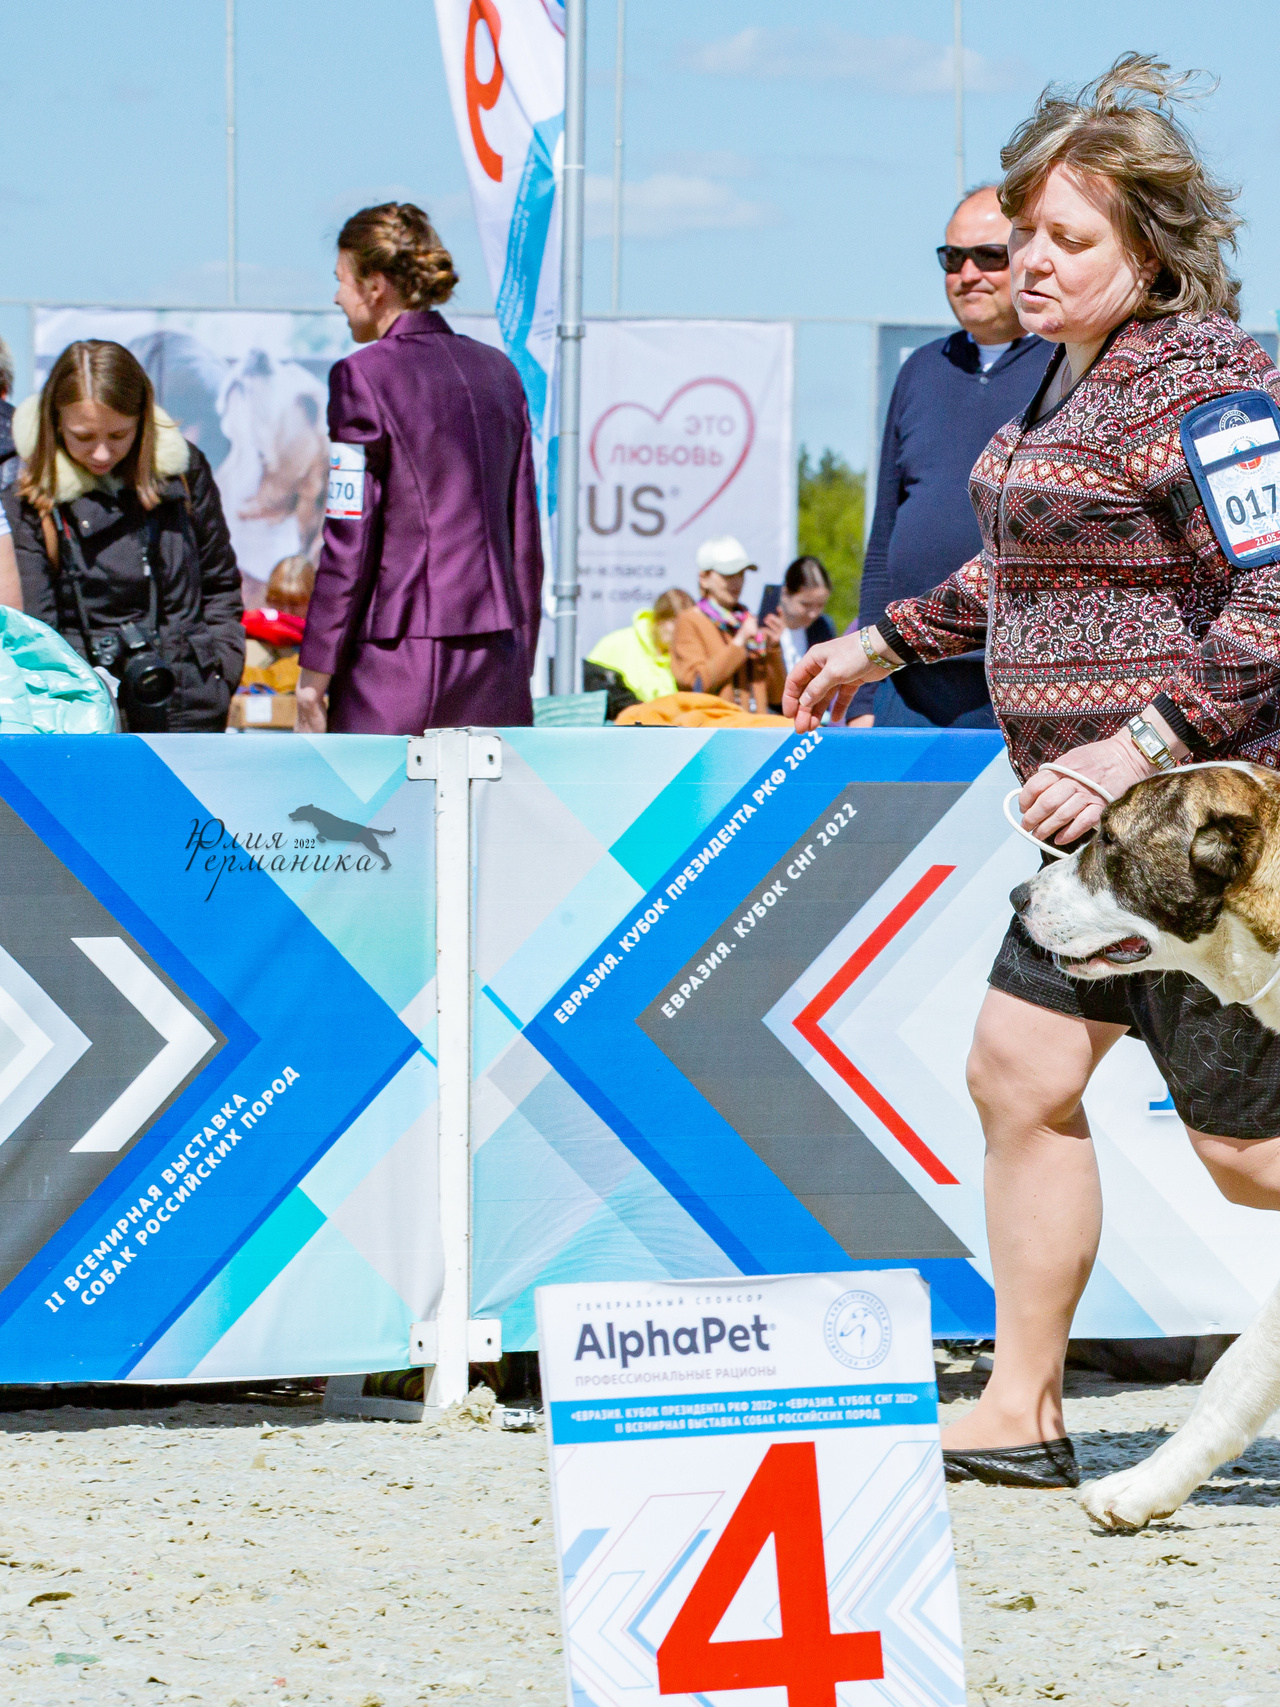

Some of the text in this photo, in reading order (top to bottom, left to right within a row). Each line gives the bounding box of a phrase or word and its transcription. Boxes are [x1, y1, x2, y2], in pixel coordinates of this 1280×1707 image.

[685, 415, 735, 435] ЭТО
[610, 444, 724, 466] ЛЮБОВЬ
[586, 485, 666, 537] US
[554, 730, 823, 1024] ЕВРАЗИЯ. КУБОК ПРЕЗИДЕНТА РКФ 2022
[661, 803, 857, 1019] ЕВРАЗИЯ. КУБОК СНГ 2022
[44, 1094, 248, 1312] II ВСЕМИРНАЯ ВЫСТАВКА
[80, 1066, 300, 1306] СОБАК РОССИЙСКИХ ПОРОД
[577, 1294, 763, 1310] ГЕНЕРАЛЬНЫЙ СПОНСОР
[574, 1314, 770, 1368] AlphaPet
[575, 1366, 777, 1387] ПРОФЕССИОНАЛЬНЫЕ РАЦИОНЫ
[625, 1406, 659, 1418] КУБОК
[661, 1402, 725, 1416] ПРЕЗИДЕНТА
[727, 1401, 749, 1412] РКФ
[838, 1394, 872, 1406] КУБОК
[874, 1393, 893, 1404] СНГ
[625, 1419, 685, 1433] ВСЕМИРНАЯ
[688, 1415, 741, 1429] ВЫСТАВКА
[743, 1414, 776, 1426] СОБАК
[777, 1409, 843, 1424] РОССИЙСКИХ
[845, 1408, 881, 1420] ПОРОД
[656, 1441, 884, 1707] 4
